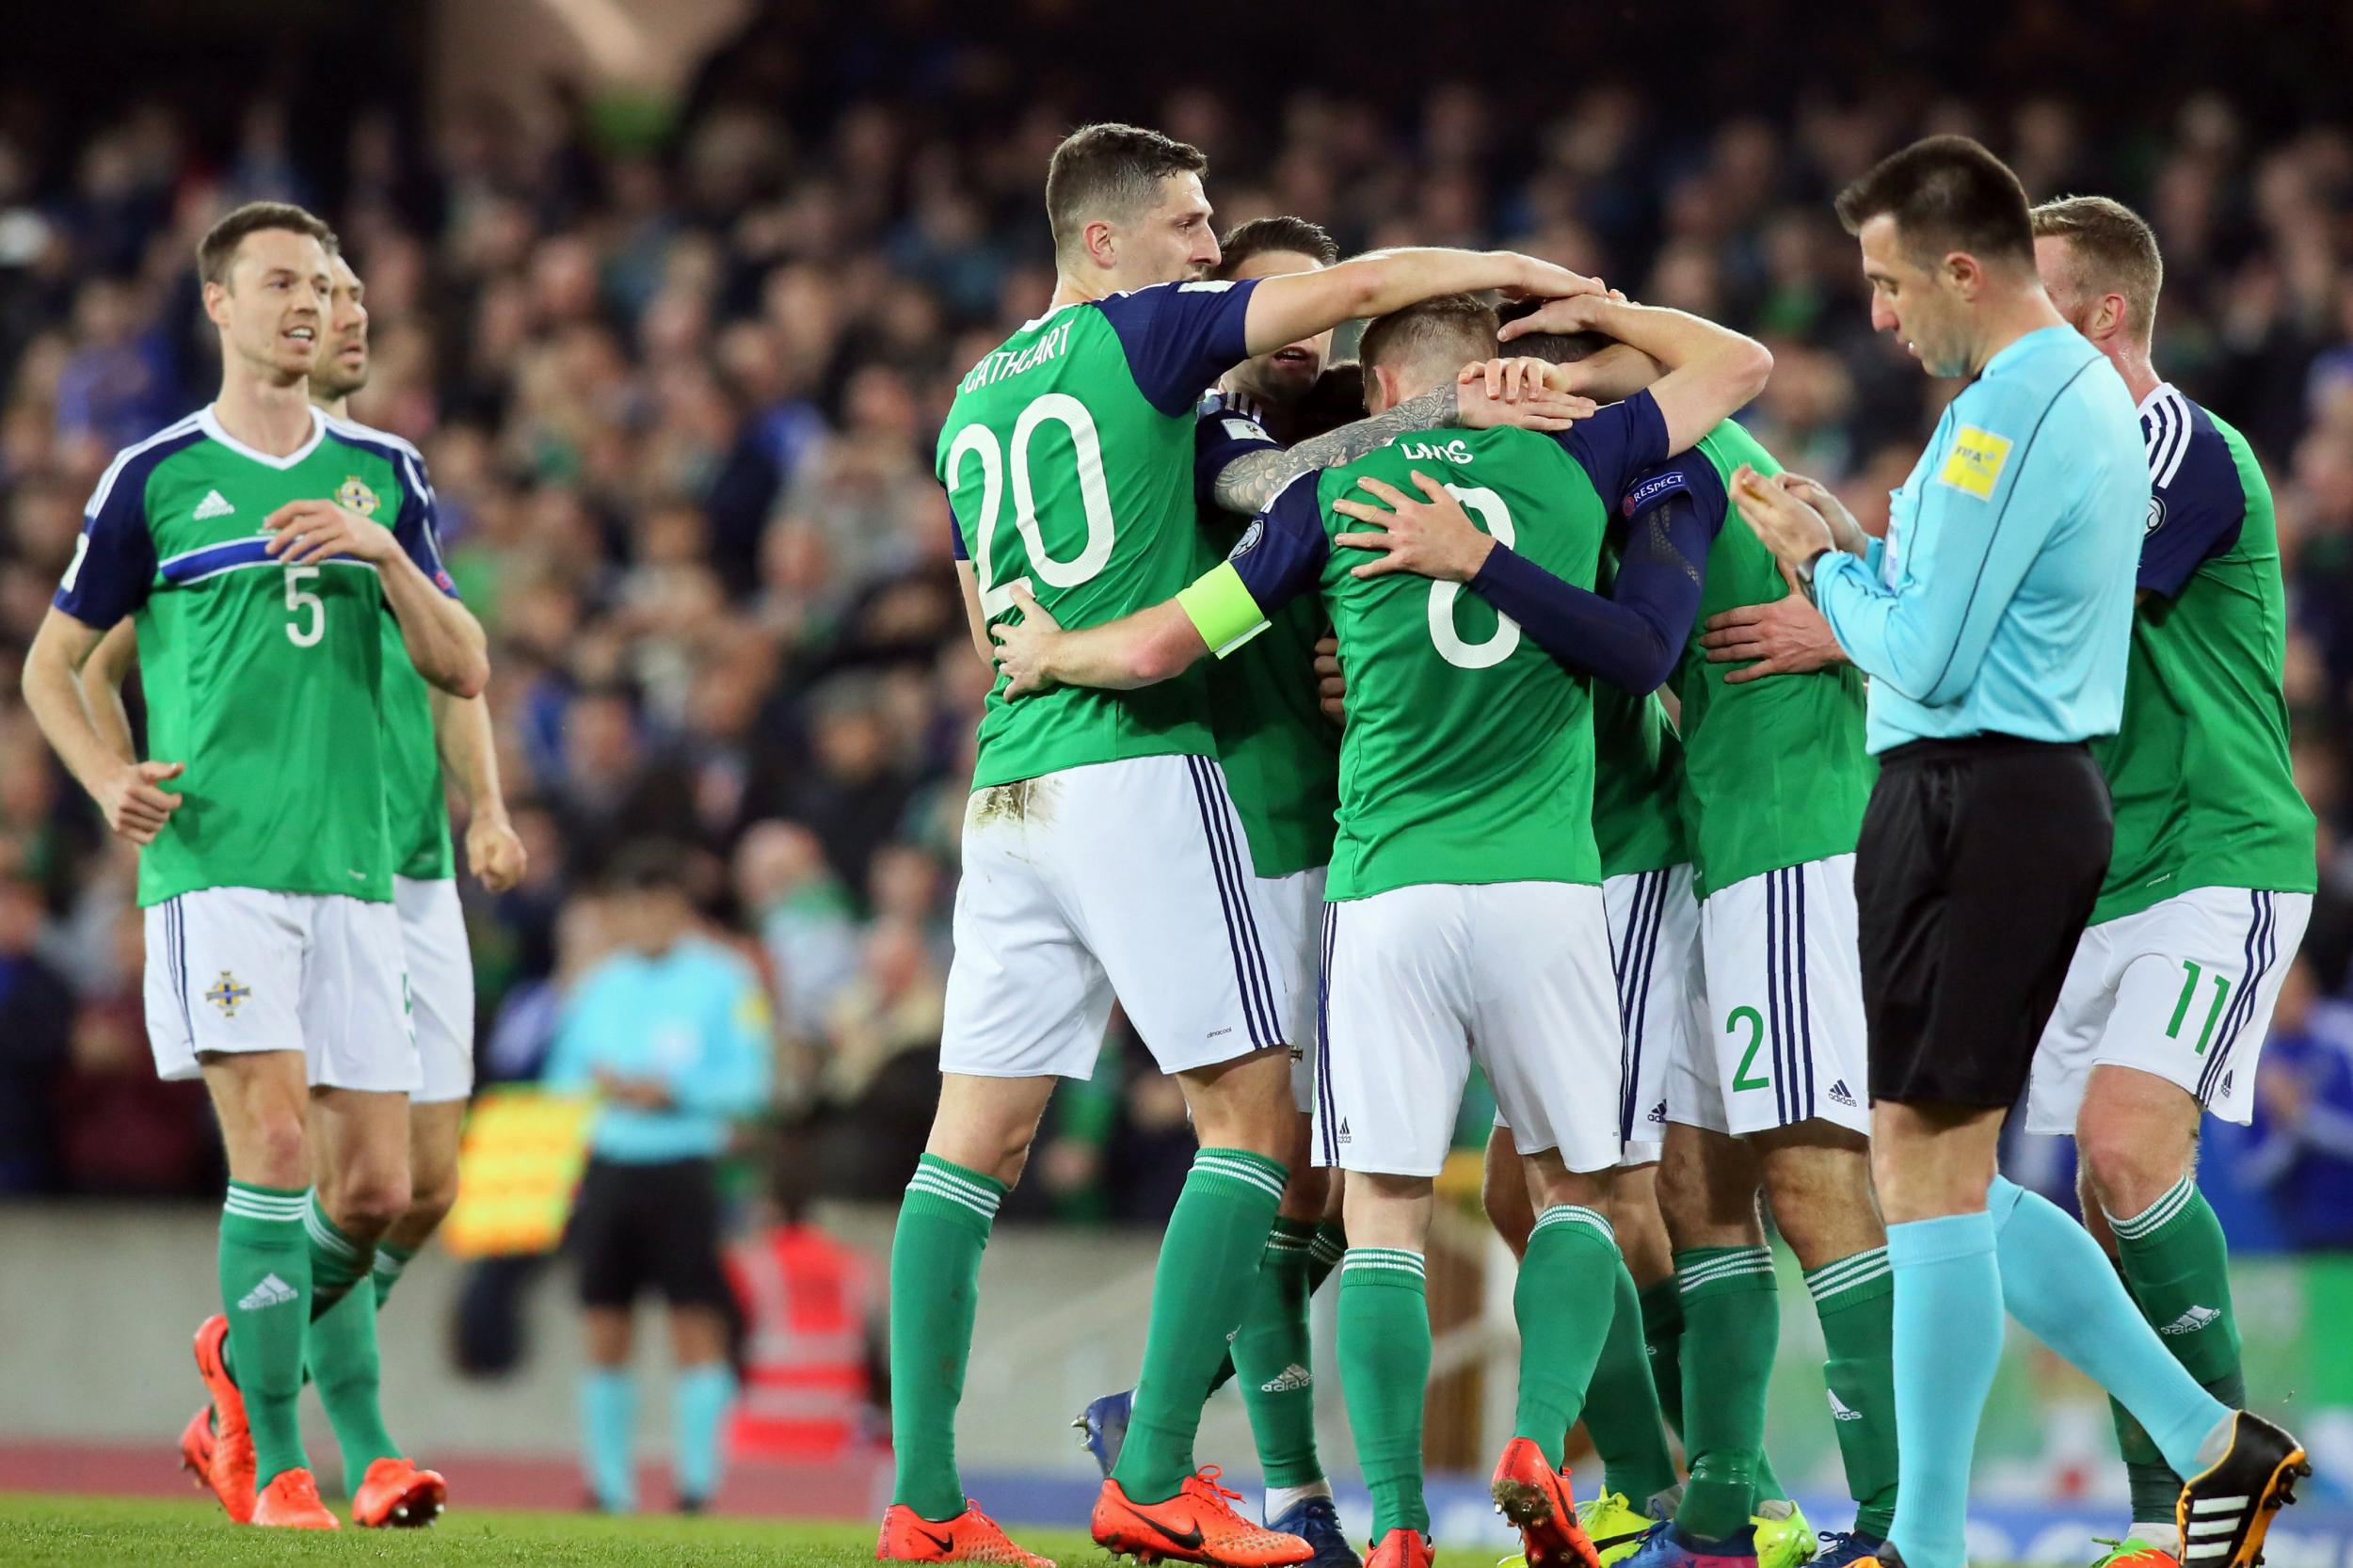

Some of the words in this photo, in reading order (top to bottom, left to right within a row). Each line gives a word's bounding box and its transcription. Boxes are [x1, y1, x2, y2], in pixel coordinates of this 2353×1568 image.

[965, 318, 1075, 394] CATHCART
[948, 393, 1114, 621] 20
[1634, 475, 1684, 503] RESPECT
[285, 567, 325, 648] 5
[2166, 960, 2231, 1055] 11
[1726, 1006, 1769, 1092] 2
[2160, 1308, 2221, 1335] adidas
[1261, 1374, 1312, 1392] adida
